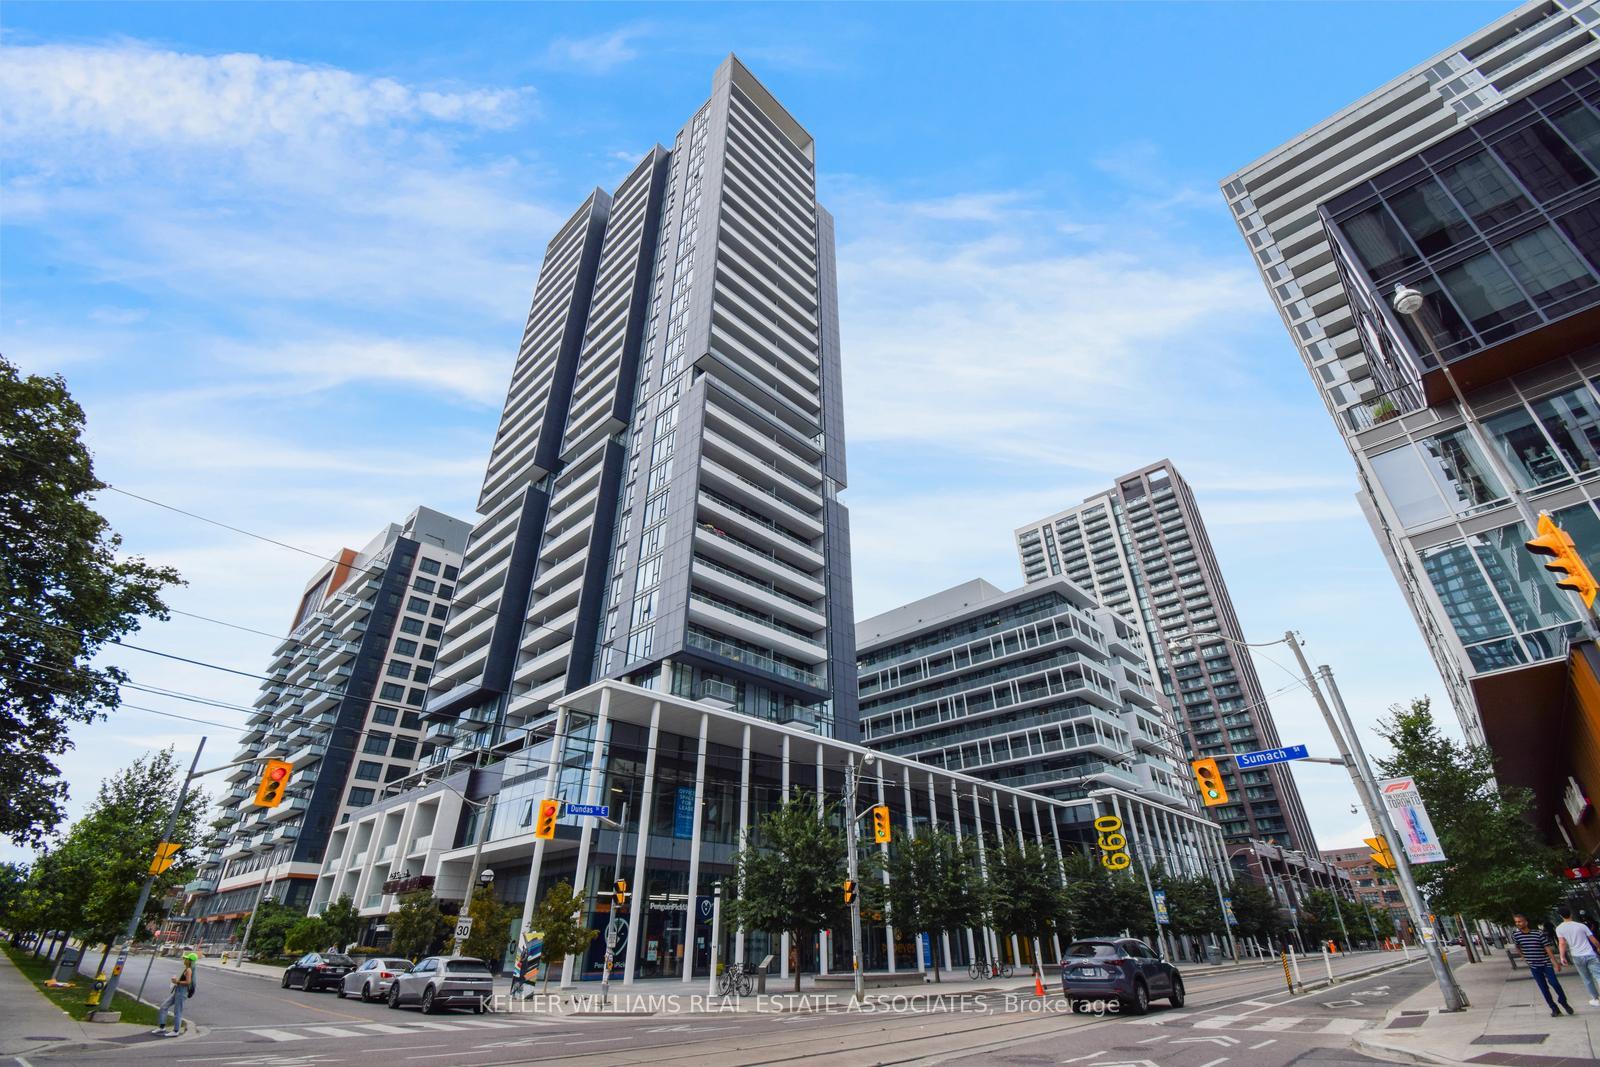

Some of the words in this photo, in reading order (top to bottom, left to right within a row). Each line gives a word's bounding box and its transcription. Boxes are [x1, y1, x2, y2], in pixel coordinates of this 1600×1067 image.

[1242, 749, 1287, 764] Sumach
[1388, 796, 1421, 808] TORONTO
[571, 805, 593, 814] Dundas
[601, 806, 606, 815] E
[1094, 815, 1132, 870] 660
[649, 901, 688, 912] PenguinPickU
[456, 925, 470, 936] 30
